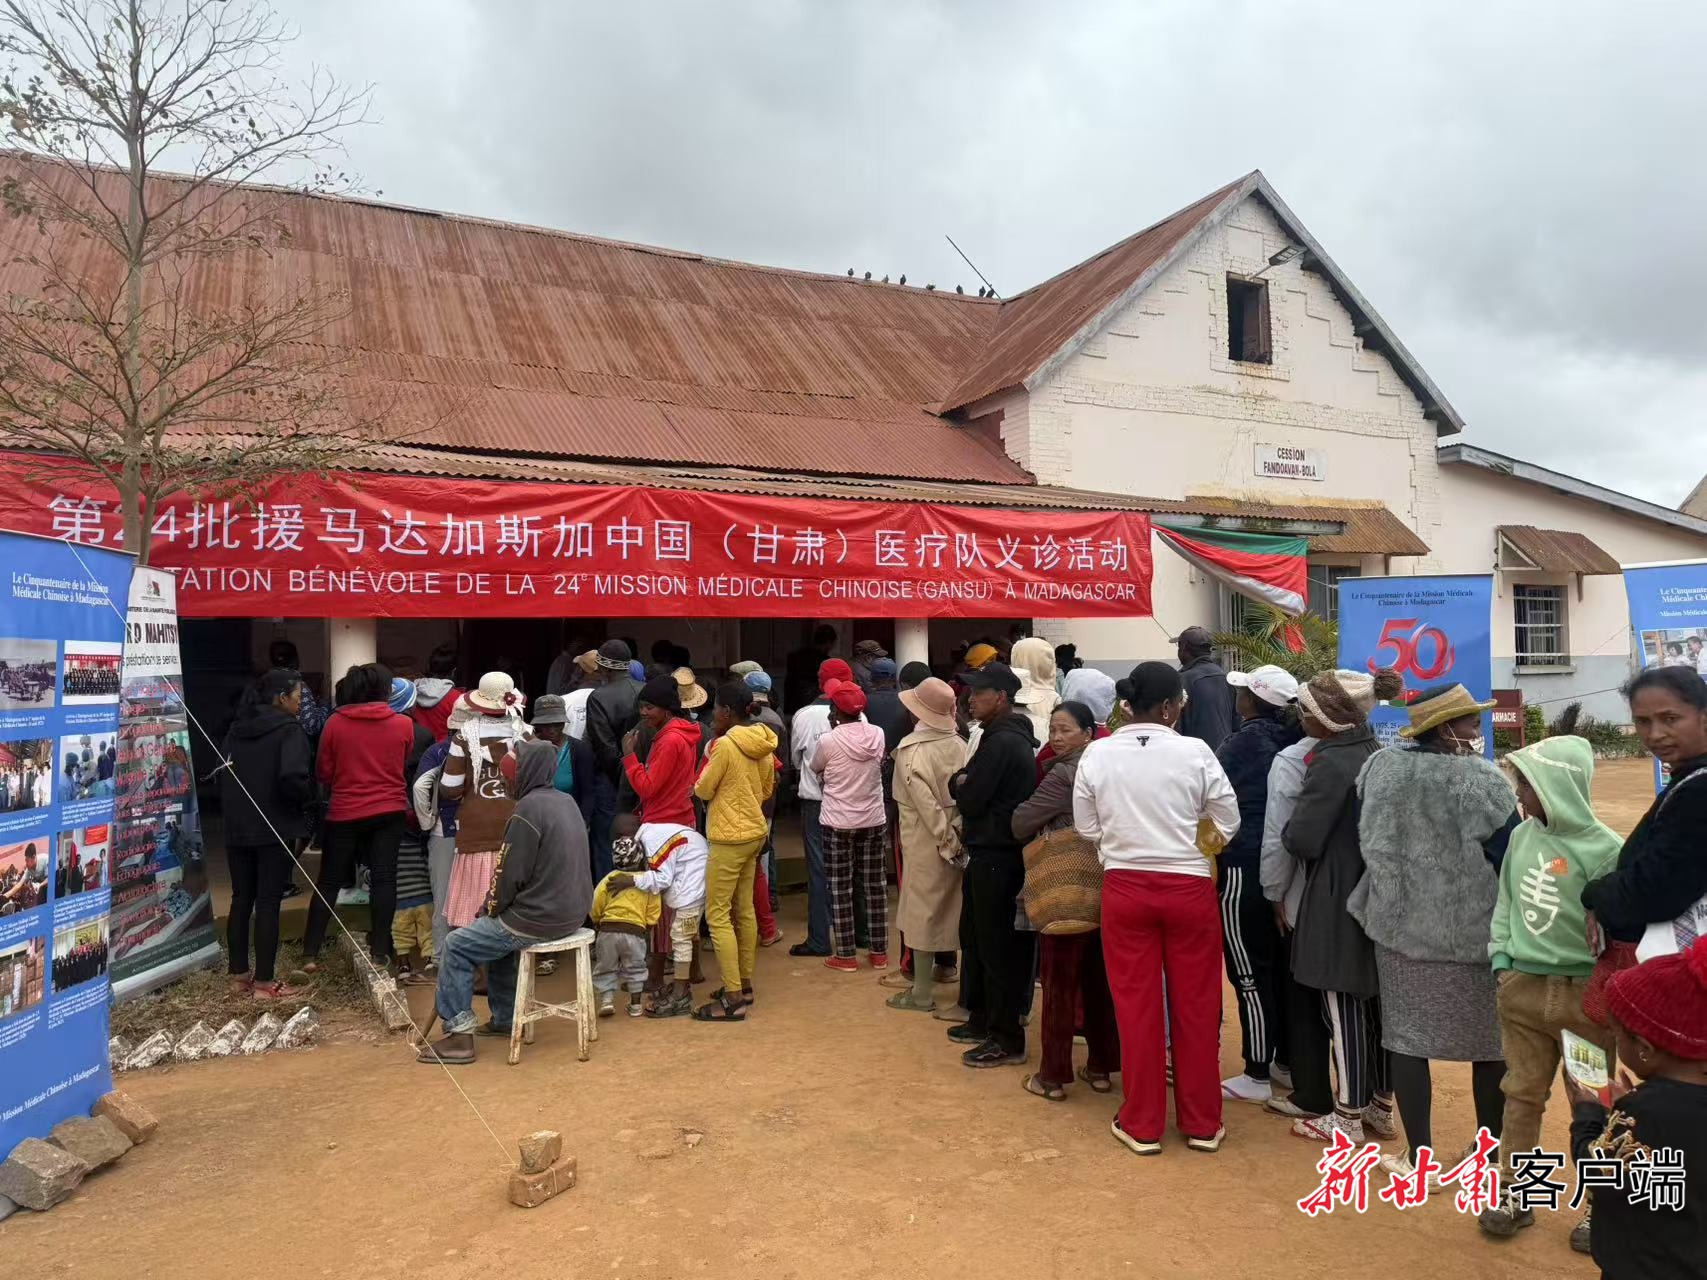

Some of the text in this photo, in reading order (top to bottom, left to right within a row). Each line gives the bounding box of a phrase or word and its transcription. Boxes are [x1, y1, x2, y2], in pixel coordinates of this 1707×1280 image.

[1277, 447, 1305, 461] CESSION
[12, 571, 21, 584] Le
[23, 573, 71, 590] Cinquantenaire
[72, 580, 79, 590] de
[289, 564, 441, 593] BÉNÉVOLE
[456, 572, 490, 594] DE
[506, 573, 535, 595] LA
[594, 575, 687, 595] MISSION
[698, 573, 803, 597] MÉDICALE
[1005, 579, 1016, 599] À
[1024, 583, 1136, 600] MADAGASCAR
[12, 585, 41, 600] Médicale
[42, 588, 69, 602] Chinoise
[1351, 592, 1359, 600] Le
[1367, 617, 1455, 681] 50
[1491, 711, 1517, 723] ARMACIE
[479, 767, 504, 780] GU
[2, 1105, 23, 1122] Mission
